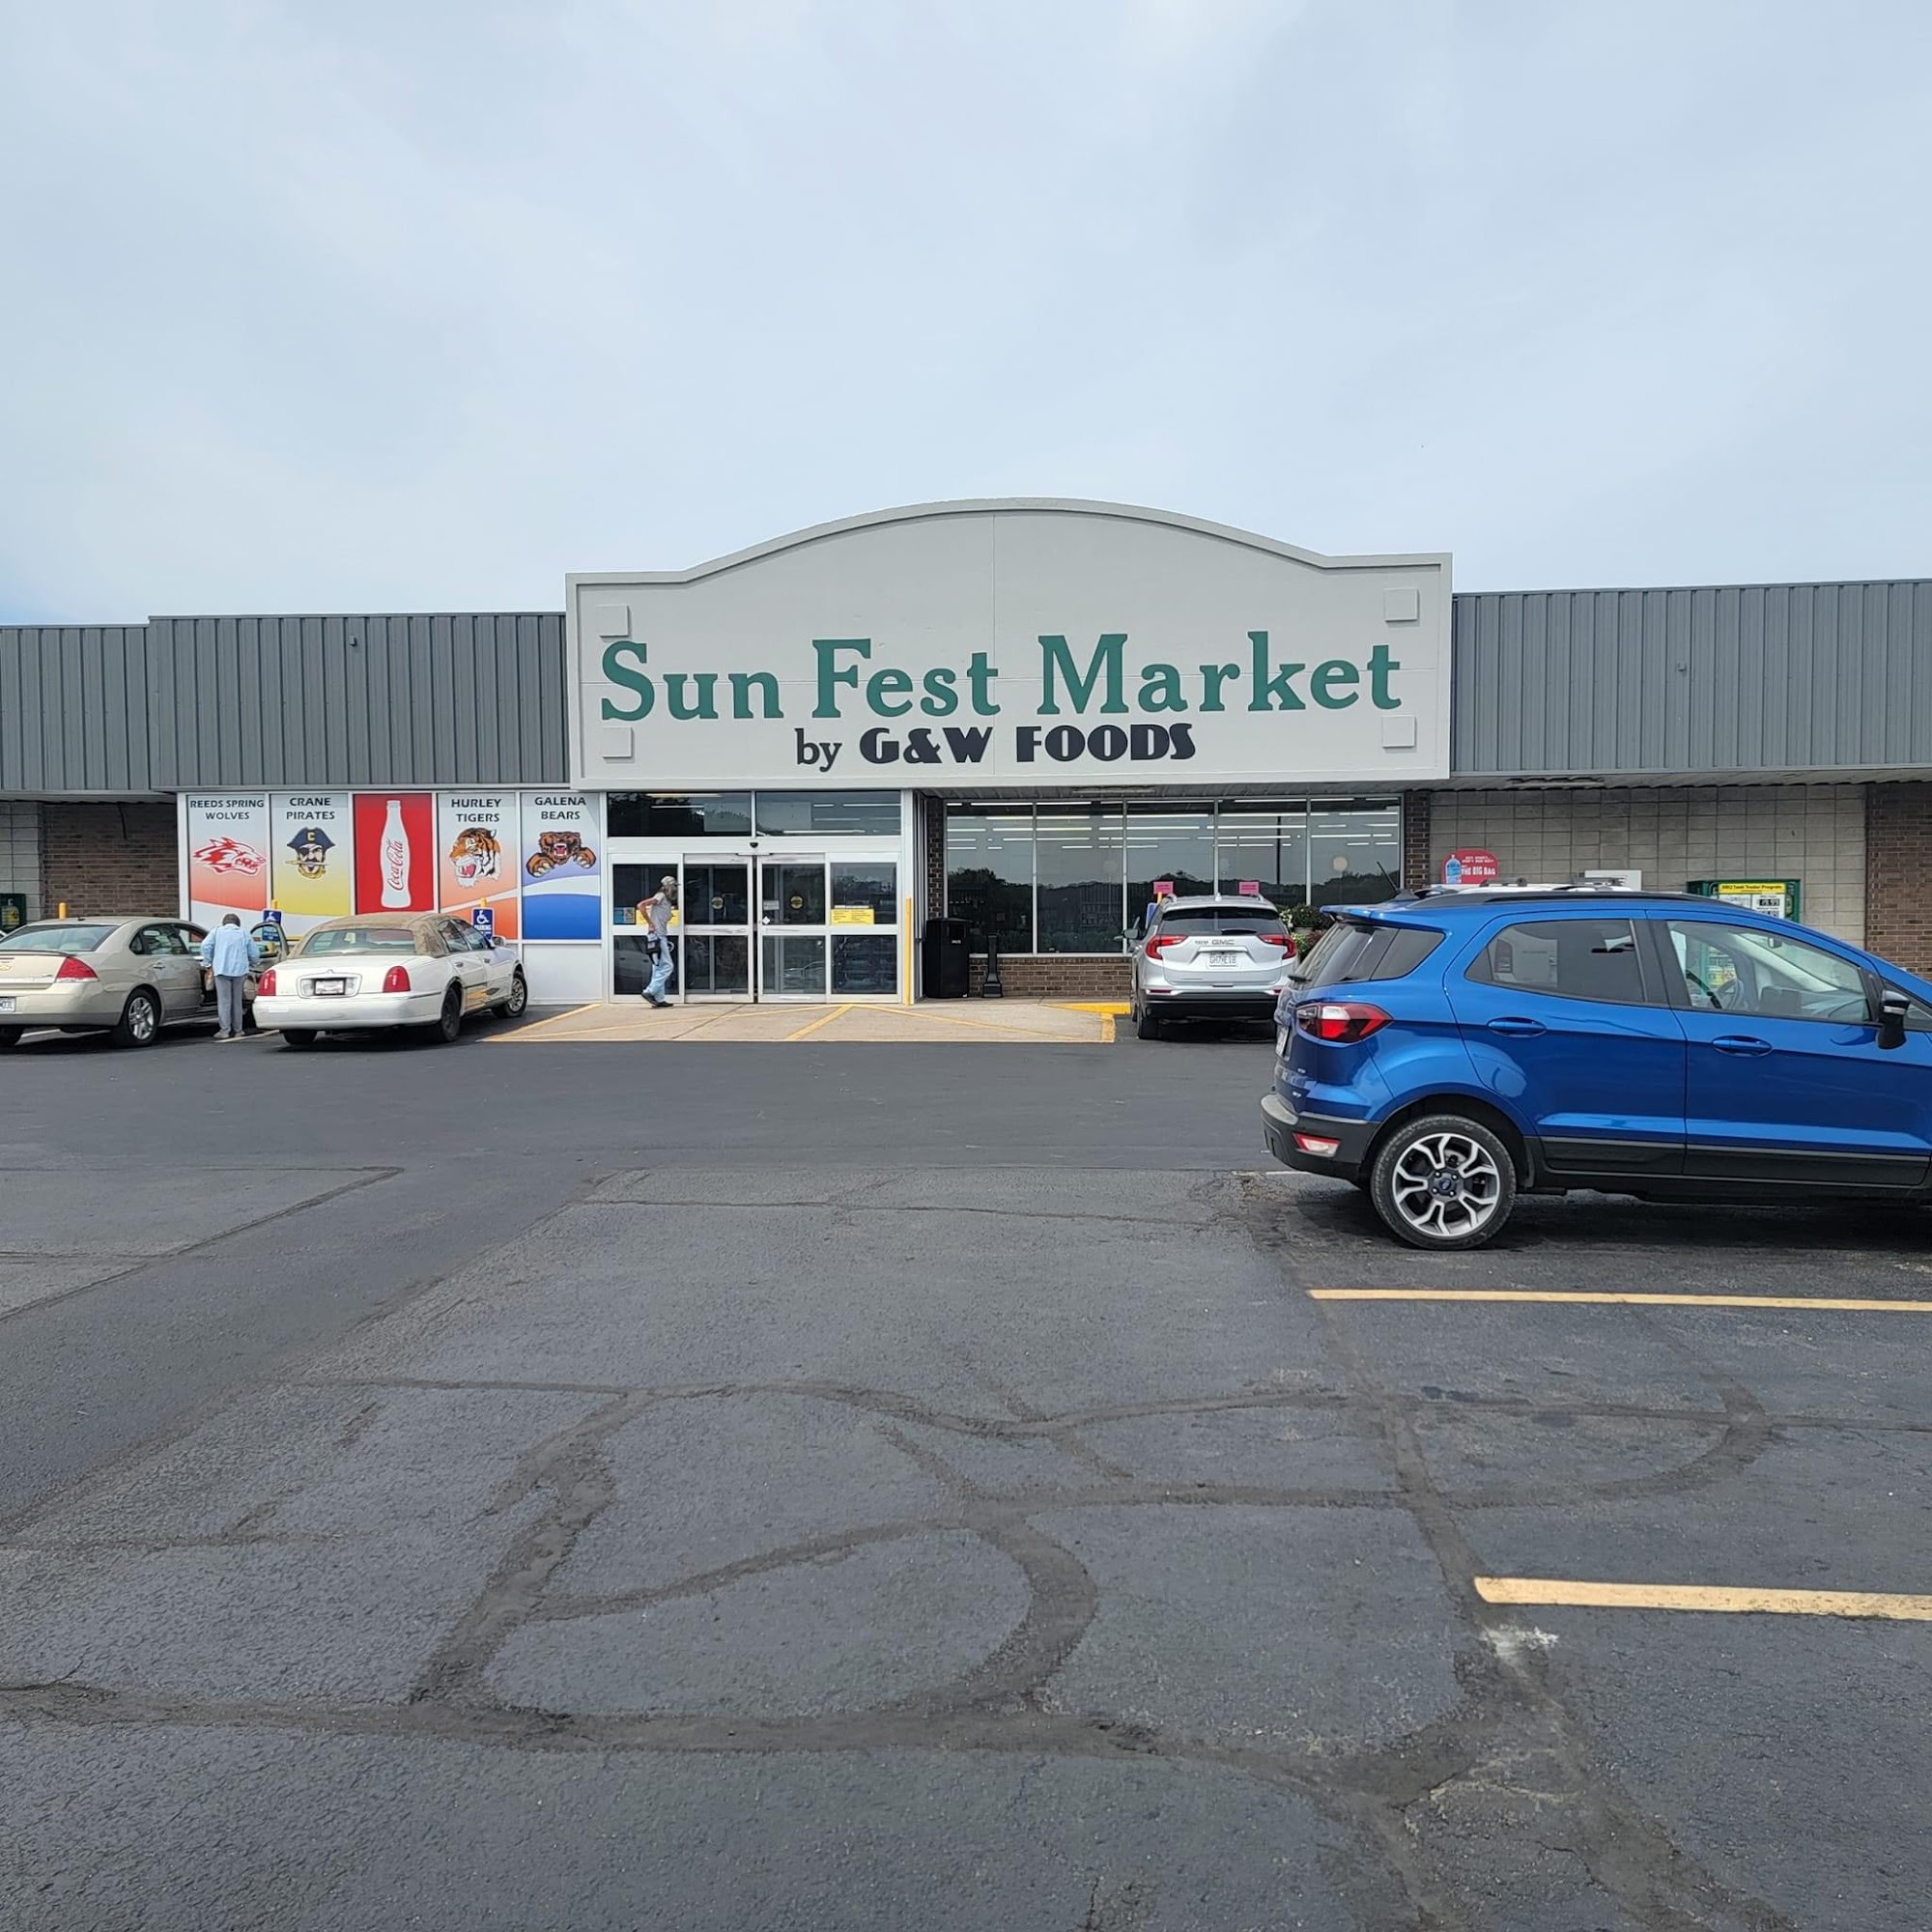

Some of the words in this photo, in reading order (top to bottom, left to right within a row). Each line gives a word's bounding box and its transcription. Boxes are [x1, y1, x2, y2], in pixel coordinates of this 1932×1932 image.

[602, 640, 783, 721] Sun
[813, 639, 999, 719] Fest
[1038, 631, 1400, 715] Market
[795, 727, 842, 771] by
[860, 726, 993, 764] G&W
[1016, 723, 1196, 762] FOODS
[190, 800, 223, 809] REEDS
[226, 800, 265, 809] SPRING
[290, 797, 331, 807] CRANE
[451, 798, 501, 809] HURLEY
[535, 796, 586, 807] GALENA
[206, 811, 250, 820] WOLVES
[287, 810, 335, 820] PIRATES
[456, 812, 500, 823] TIGERS
[541, 810, 581, 820] BEARS
[307, 831, 316, 841] C
